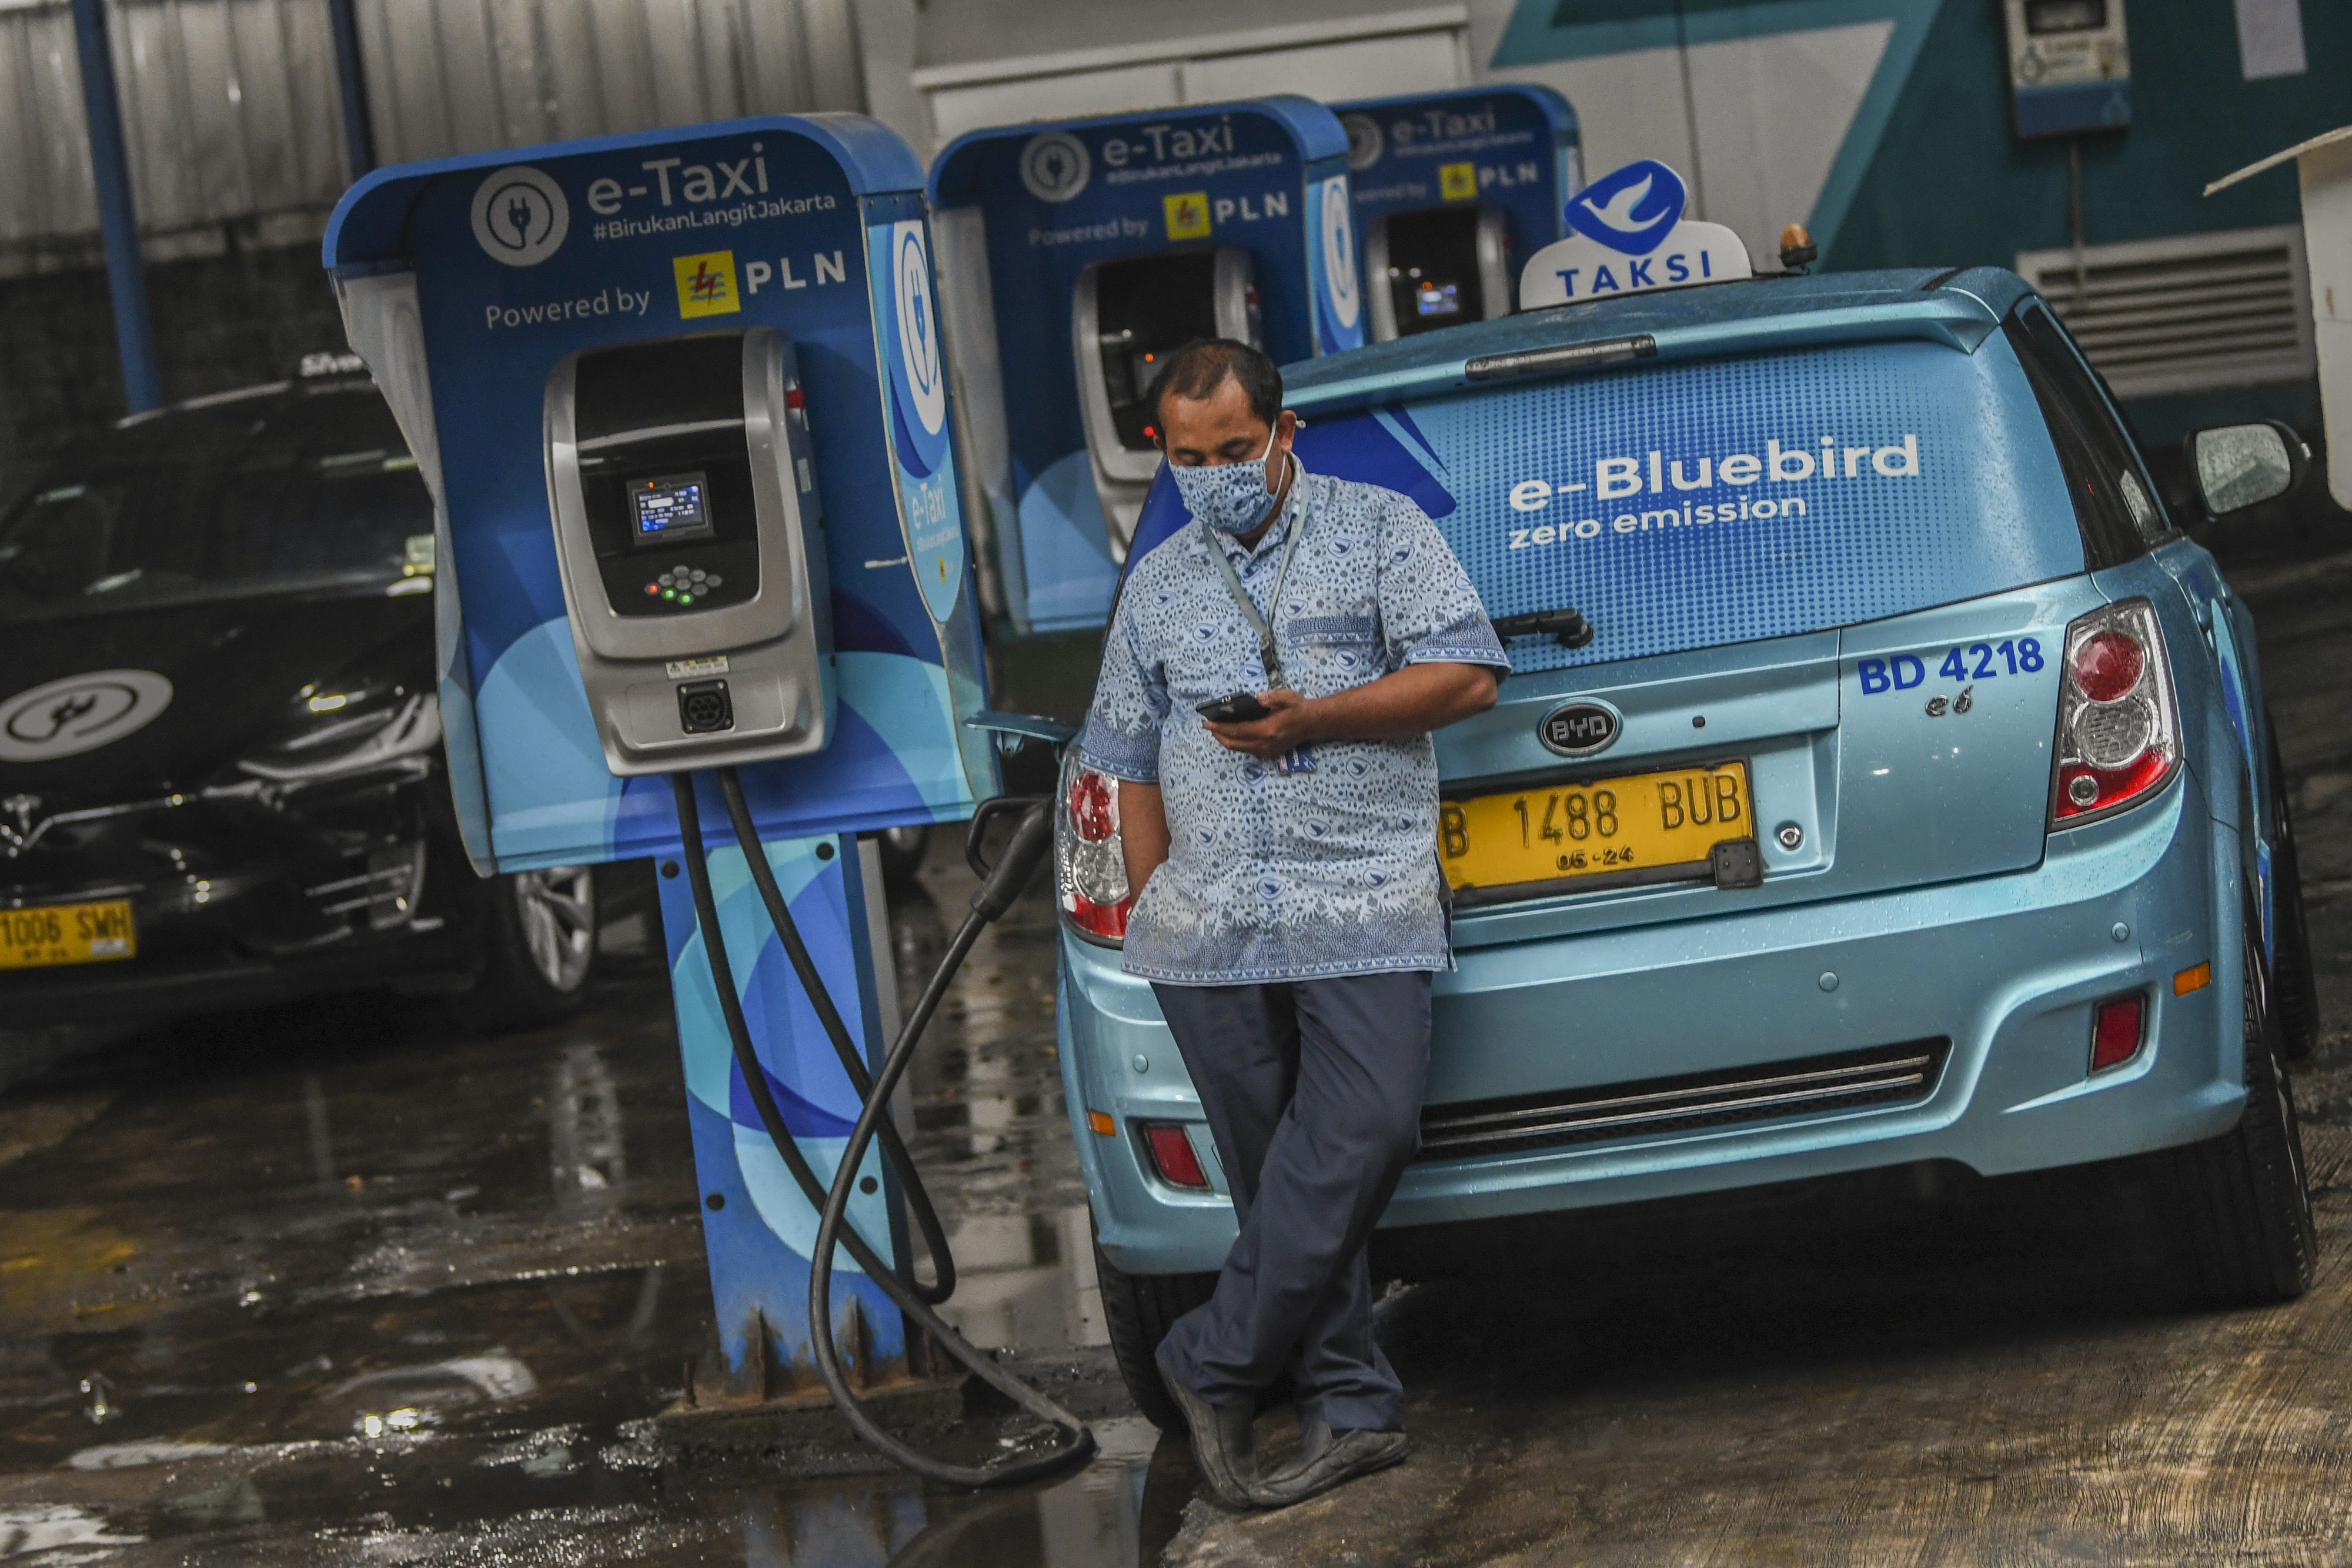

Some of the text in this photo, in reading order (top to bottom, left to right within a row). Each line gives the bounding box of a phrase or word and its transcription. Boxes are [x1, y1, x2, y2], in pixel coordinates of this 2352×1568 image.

[1102, 115, 1234, 166] e-Taxi
[588, 142, 768, 216] e-Taxi
[1479, 162, 1538, 189] PLN
[592, 193, 836, 241] #BirukanLangitJakarta
[1215, 190, 1289, 225] PLN
[745, 250, 846, 294] PLN
[1556, 250, 1712, 297] TAKSI
[486, 287, 650, 329] Powered by
[1509, 433, 1920, 513] e-Bluebird
[913, 473, 947, 529] e-Taxi
[1508, 494, 1807, 550] zero emission
[1857, 637, 2045, 696] BD 4218
[1552, 715, 1608, 742] BYD
[1440, 770, 1742, 860] B 1488 BUB
